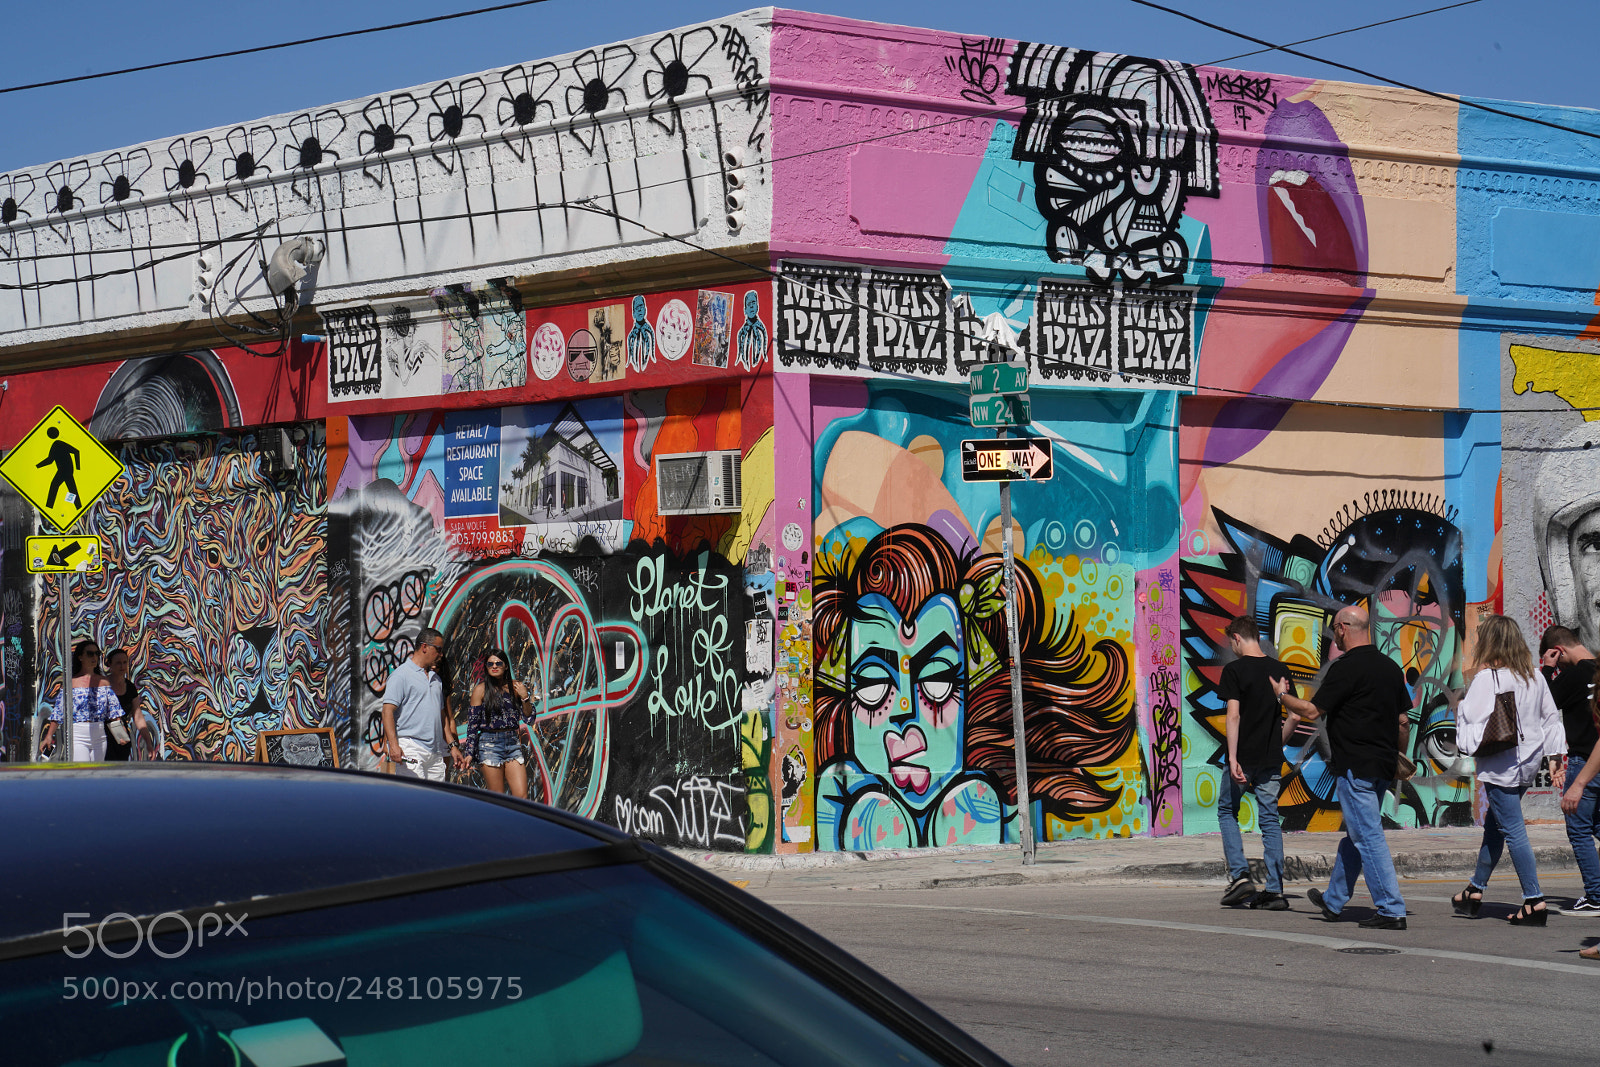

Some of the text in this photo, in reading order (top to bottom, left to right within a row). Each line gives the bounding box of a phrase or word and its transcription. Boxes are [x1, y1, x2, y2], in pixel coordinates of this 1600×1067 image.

[783, 275, 853, 311] MAS
[873, 283, 940, 318] MAS
[1043, 293, 1108, 327] MAS
[1123, 297, 1190, 331] MAS
[328, 313, 377, 345] MAS
[783, 309, 854, 354] PAZ
[873, 316, 942, 359] PAZ
[1043, 325, 1107, 366] PAZ
[1124, 329, 1186, 370] PAZ
[333, 343, 379, 384] PAZ
[972, 368, 1026, 391] NW 2 AV
[973, 400, 1030, 423] NW 24 ST
[455, 425, 483, 440] RETAIL
[447, 443, 499, 461] RESTAURANT
[978, 451, 1035, 468] ONE WAY
[459, 466, 484, 482] SPACE
[451, 486, 493, 503] AVAILABLE
[450, 521, 487, 532] SARA WOLFE
[451, 530, 515, 545] 305.799.9883
